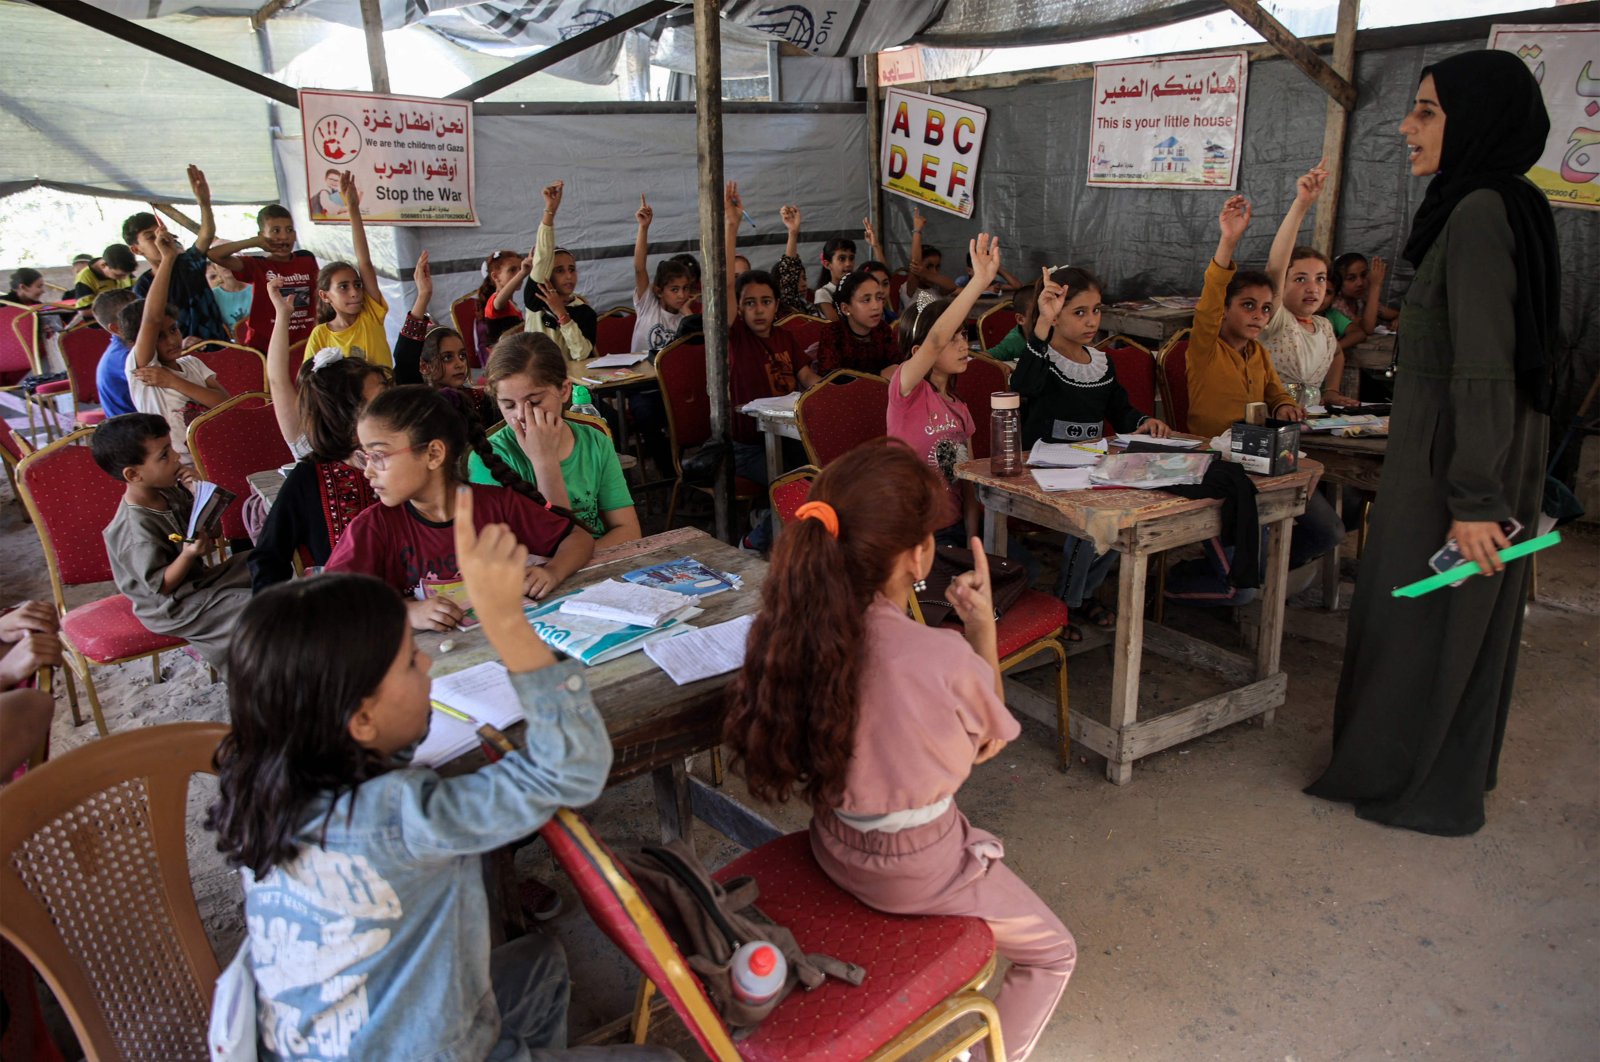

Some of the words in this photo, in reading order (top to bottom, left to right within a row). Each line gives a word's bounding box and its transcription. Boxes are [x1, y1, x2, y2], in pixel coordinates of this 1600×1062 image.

[1100, 77, 1148, 105] الصغير
[1151, 74, 1204, 103] بيتكم
[1206, 71, 1236, 95] هذا
[362, 108, 393, 133] غزة
[394, 110, 434, 134] أطفال
[435, 116, 465, 138] نحن
[891, 101, 910, 138] A
[924, 108, 945, 146] B
[953, 116, 976, 155] C
[1097, 116, 1119, 130] This
[1122, 116, 1132, 129] is
[1135, 117, 1161, 131] your
[1164, 114, 1190, 128] little
[1193, 114, 1233, 128] house
[365, 137, 378, 147] We
[380, 140, 392, 148] are
[394, 138, 405, 148] the
[407, 139, 437, 150] children
[438, 141, 445, 151] of
[446, 143, 465, 153] Gaza
[373, 159, 417, 180] الحرب
[422, 158, 458, 182] أوقفوا
[888, 144, 908, 180] D
[919, 153, 940, 192] E
[947, 161, 968, 197] F
[376, 185, 409, 204] Stop
[413, 186, 434, 202] the
[437, 188, 462, 203] War
